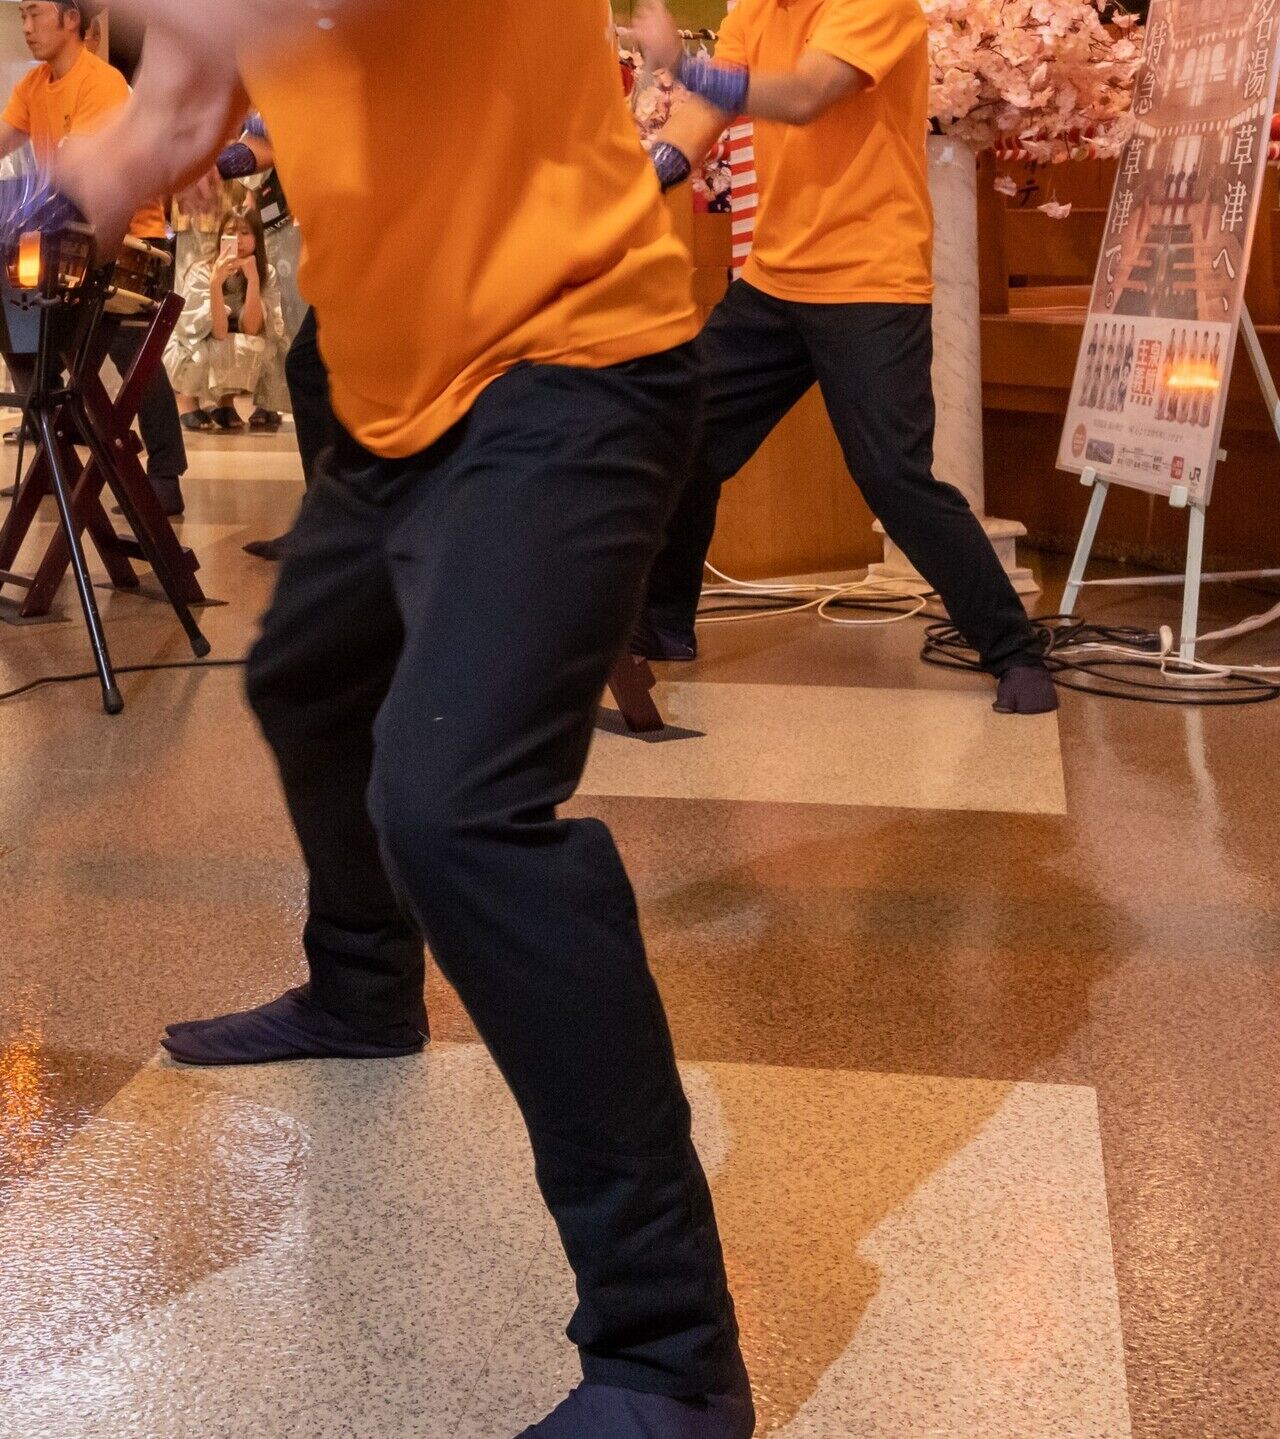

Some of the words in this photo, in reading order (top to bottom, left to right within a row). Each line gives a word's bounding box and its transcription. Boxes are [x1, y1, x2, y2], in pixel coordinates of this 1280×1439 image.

[1134, 20, 1168, 115] 特急
[1106, 138, 1145, 308] 草津で。
[1212, 124, 1257, 311] 草津へ、
[1189, 466, 1202, 482] JR
